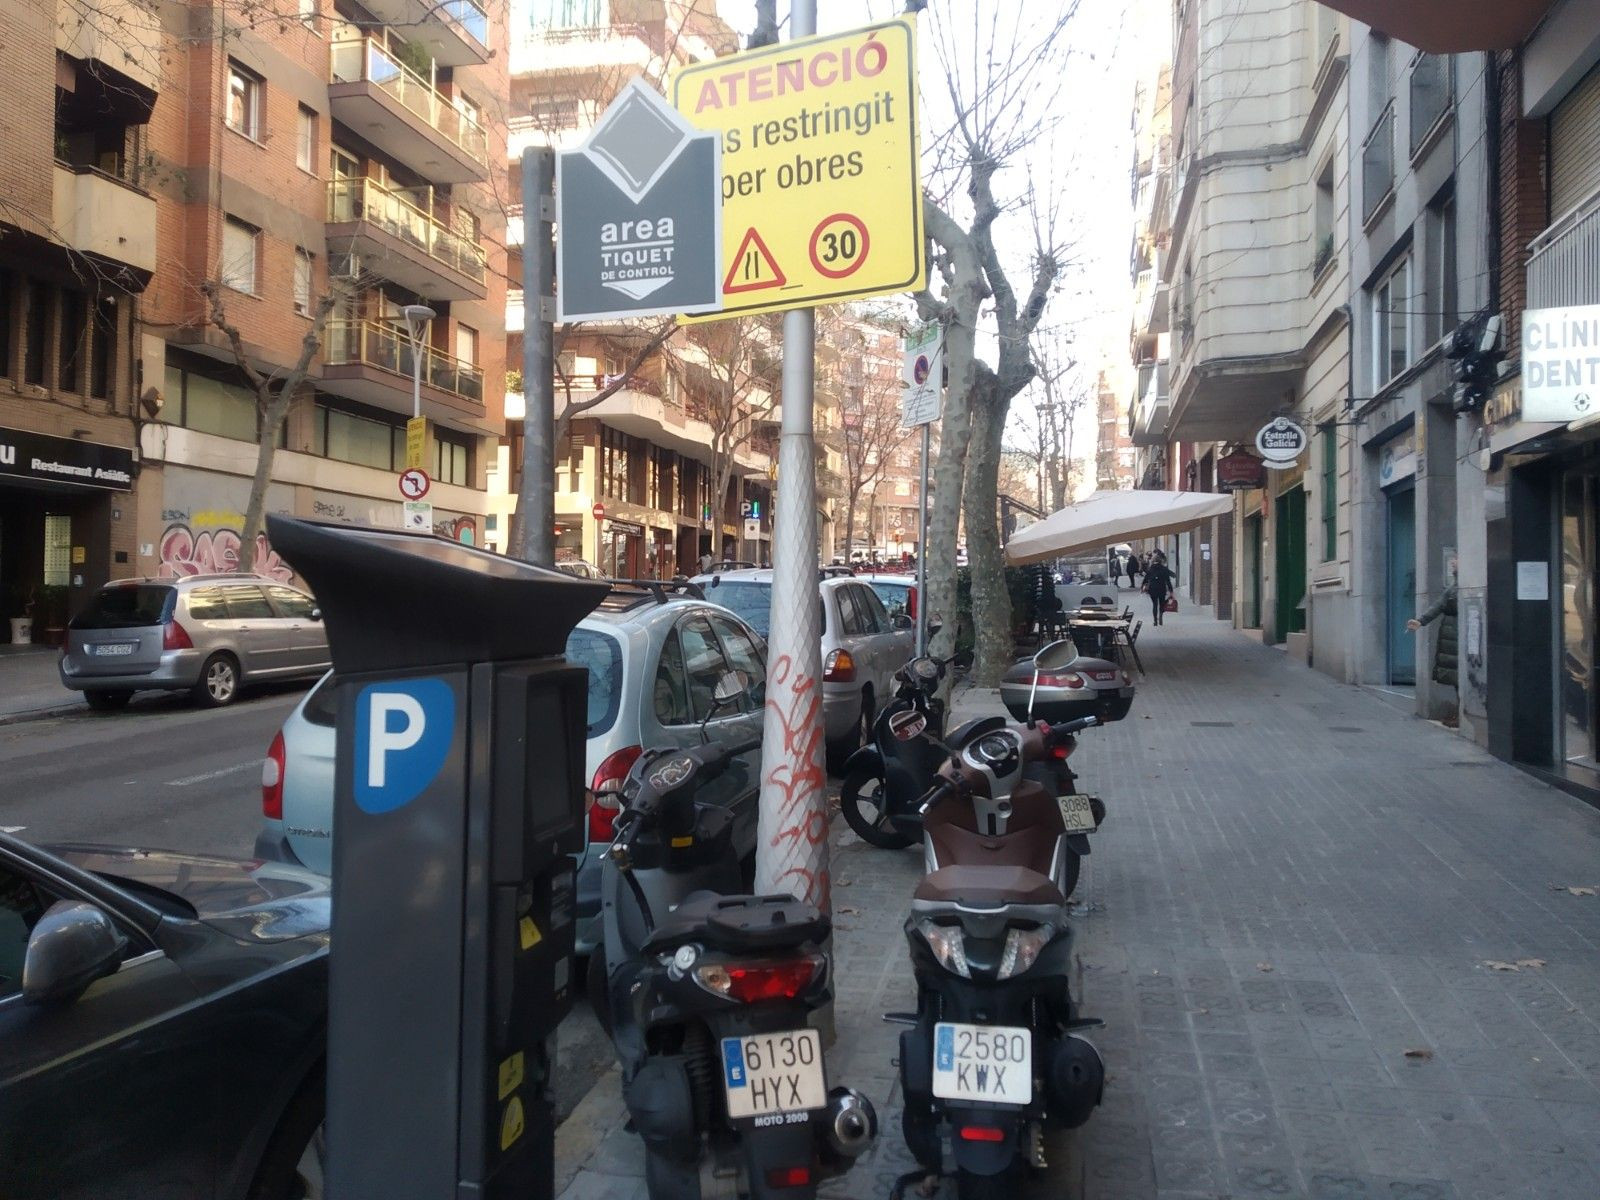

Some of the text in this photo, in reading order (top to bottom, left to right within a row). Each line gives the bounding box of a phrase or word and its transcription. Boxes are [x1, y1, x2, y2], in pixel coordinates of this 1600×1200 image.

[694, 31, 888, 114] ATENCIÓ
[752, 91, 894, 148] restringit
[721, 150, 863, 206] per obres
[601, 217, 674, 243] area
[822, 229, 857, 262] 30
[601, 247, 675, 267] TIQUET
[601, 265, 675, 280] DE CONTROL
[1527, 357, 1600, 388] DENT
[1264, 431, 1298, 440] Estrella
[1266, 439, 1297, 448] Galicia
[31, 458, 92, 477] Restaurant
[368, 692, 427, 788] P
[1064, 813, 1087, 828] HSL
[744, 1035, 814, 1071] 6130
[958, 1031, 1025, 1063] 2580
[751, 1073, 803, 1110] HYX
[957, 1062, 1006, 1096] KWX
[755, 1112, 809, 1128] MOTO 2000
